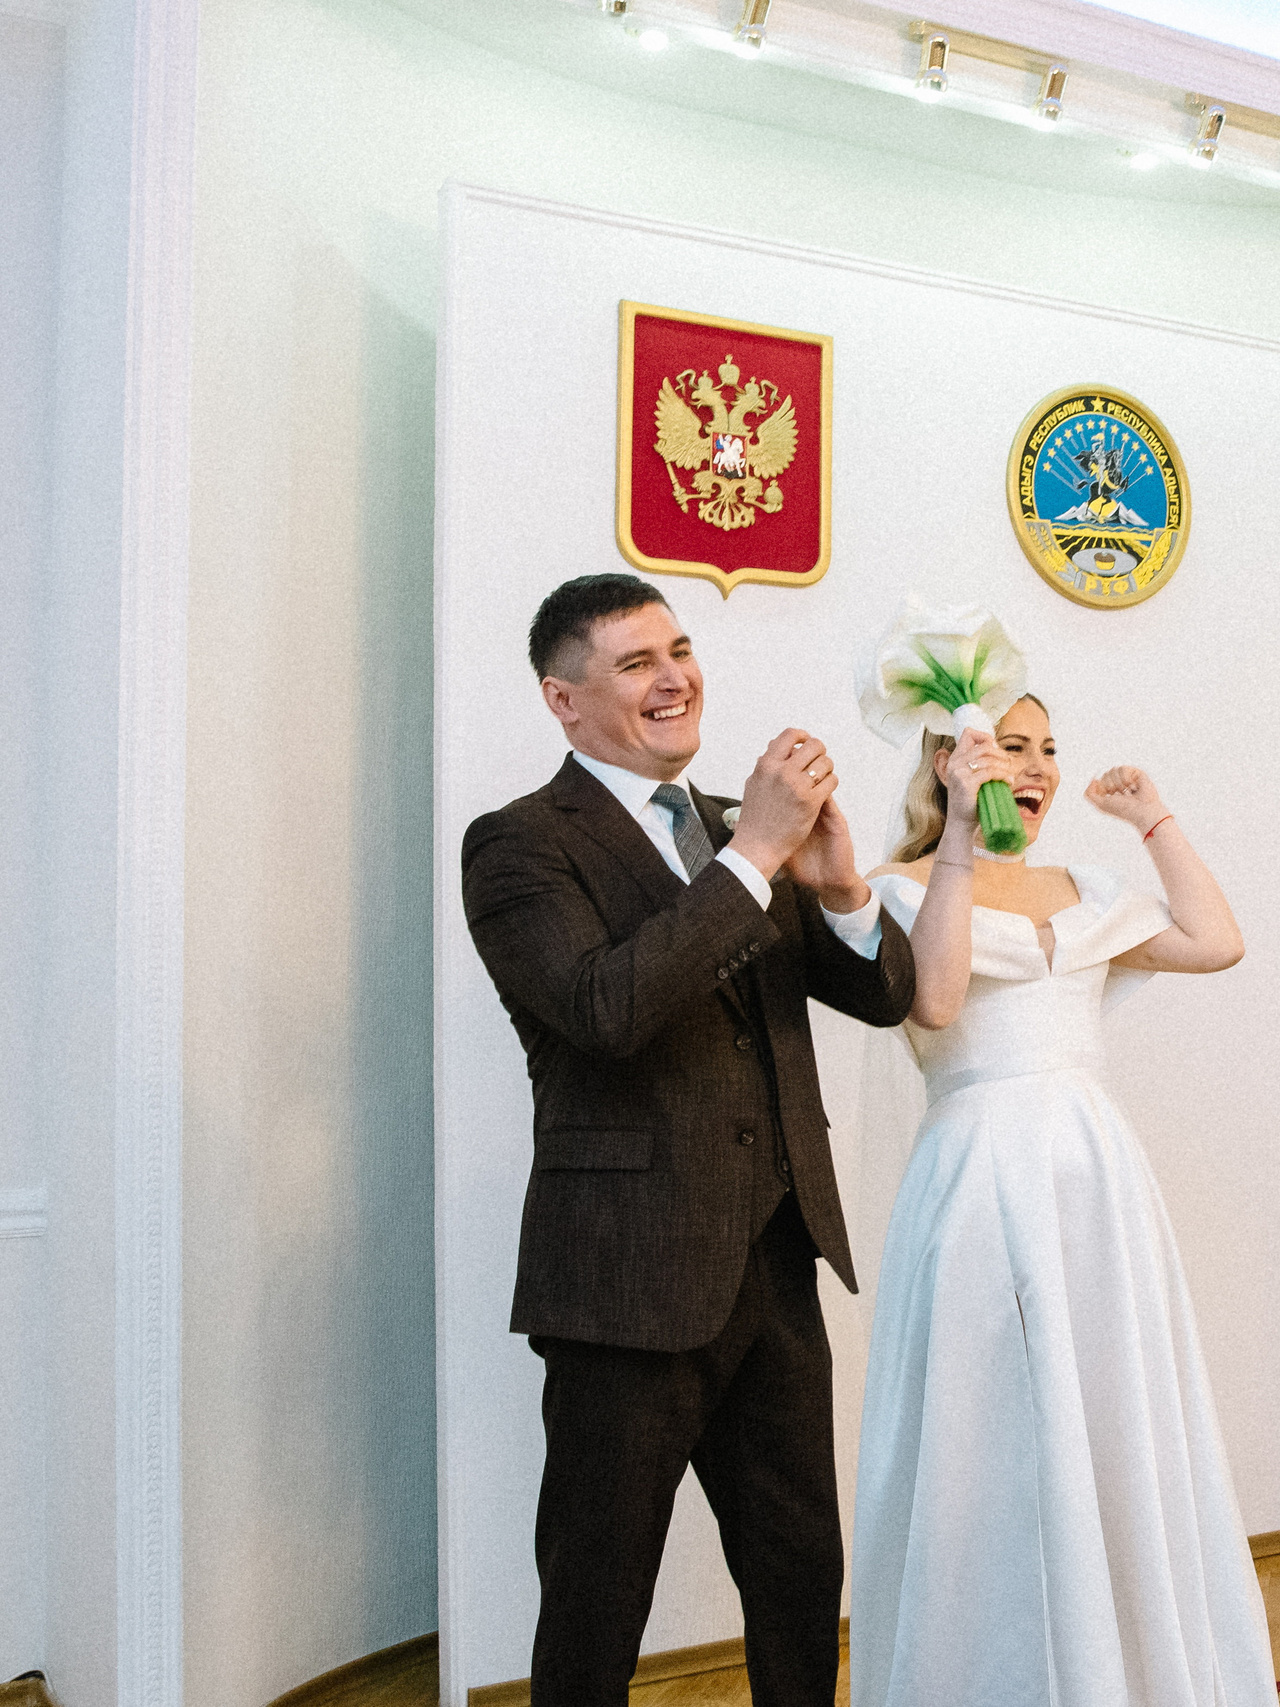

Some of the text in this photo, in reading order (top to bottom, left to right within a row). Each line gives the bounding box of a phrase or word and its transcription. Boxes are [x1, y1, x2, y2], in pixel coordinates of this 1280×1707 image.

[1021, 399, 1086, 507] АДЫГЭ РЕСПУБЛИК
[1106, 403, 1179, 524] РЕСПУБЛИКА АДЫГЕЯ
